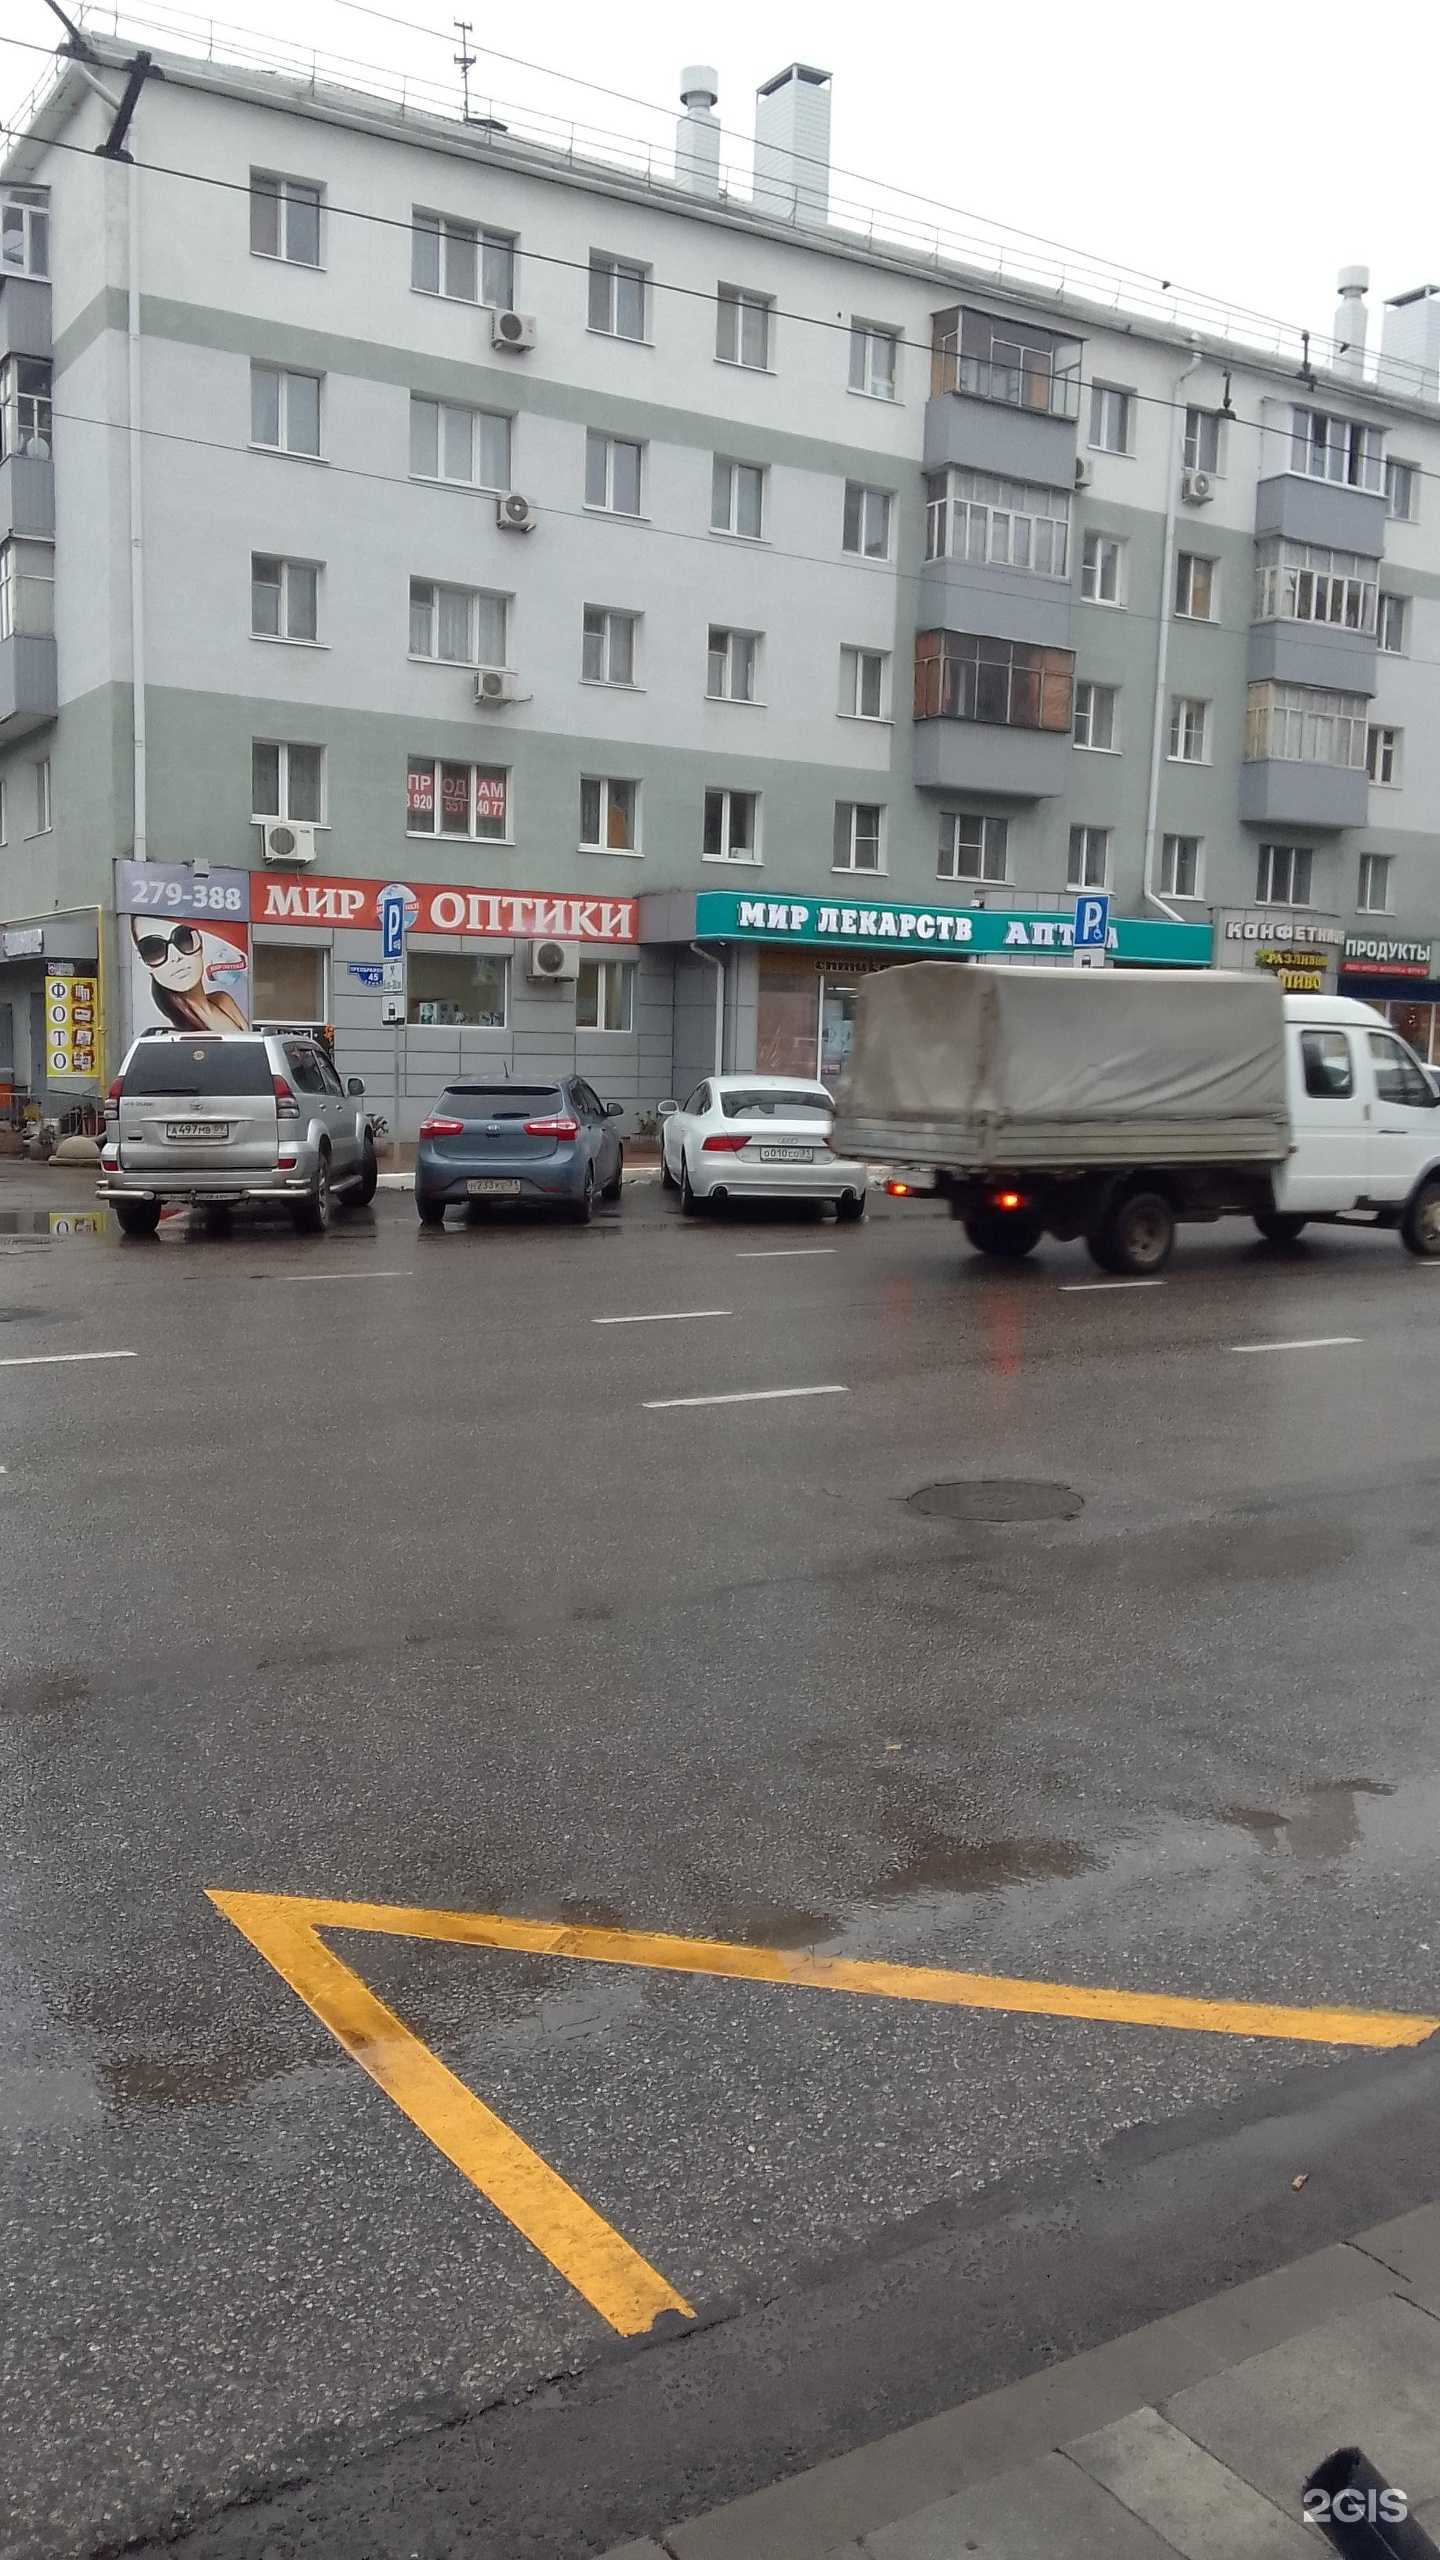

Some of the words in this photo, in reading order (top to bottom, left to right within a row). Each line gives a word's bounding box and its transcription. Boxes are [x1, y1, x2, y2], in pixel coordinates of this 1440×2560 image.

[131, 880, 242, 911] 279-388
[264, 884, 365, 920] МИР
[430, 892, 633, 939] ОПТИКИ
[738, 901, 809, 930] МИР
[816, 907, 973, 942] ЛЕКАРСТВ
[1345, 939, 1431, 961] ПРОДУКТЫ
[1282, 973, 1321, 990] ПИВО
[51, 982, 67, 1069] ФОТО
